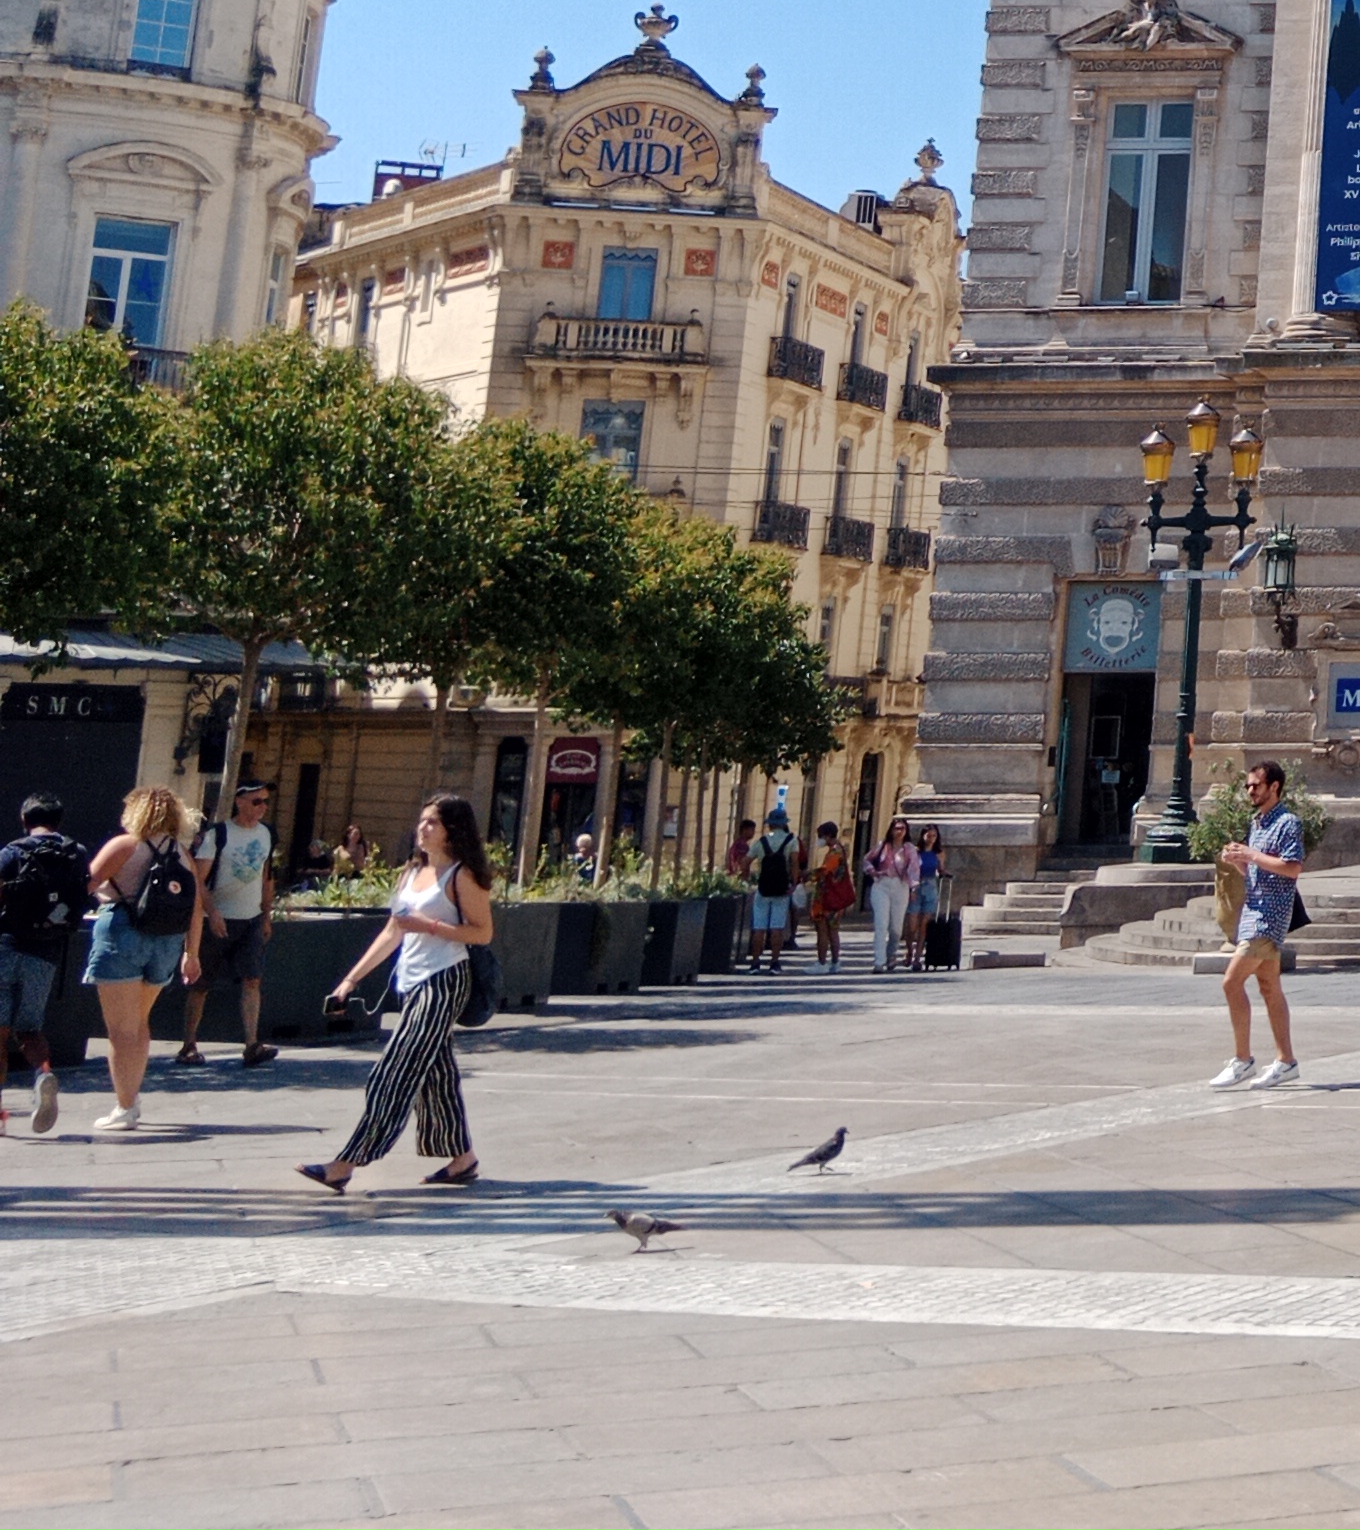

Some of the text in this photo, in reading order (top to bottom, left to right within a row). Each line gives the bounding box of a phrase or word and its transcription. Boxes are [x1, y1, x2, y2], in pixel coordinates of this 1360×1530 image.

[567, 106, 714, 162] GRAND HOTEL
[633, 128, 653, 140] DU
[597, 139, 684, 176] MIDI
[1344, 190, 1359, 199] XV
[1084, 593, 1100, 607] La
